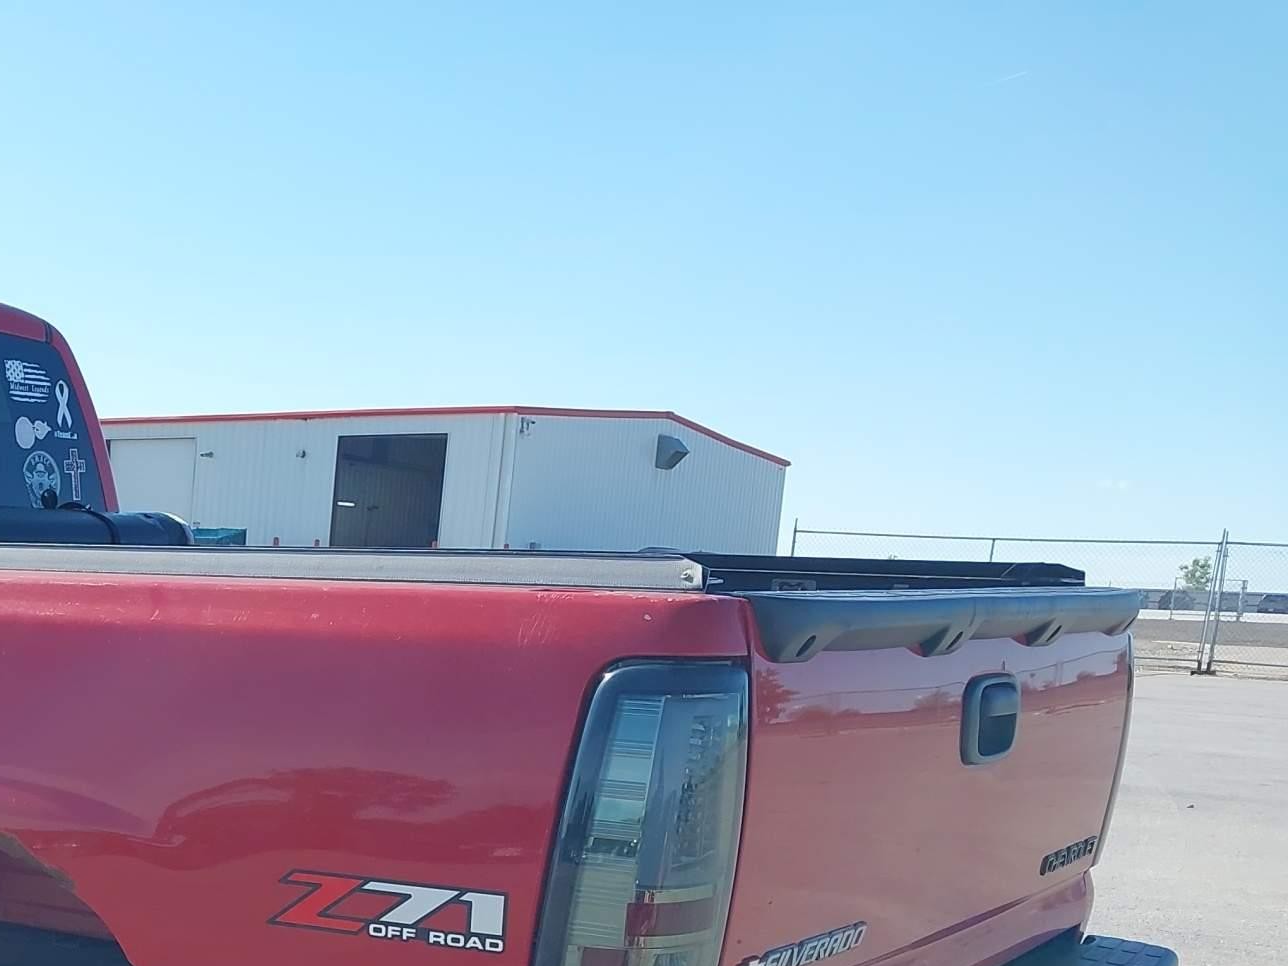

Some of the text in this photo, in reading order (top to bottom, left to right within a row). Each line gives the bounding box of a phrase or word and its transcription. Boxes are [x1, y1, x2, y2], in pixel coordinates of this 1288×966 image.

[267, 868, 508, 938] Z71
[368, 923, 504, 953] OFF ROAD
